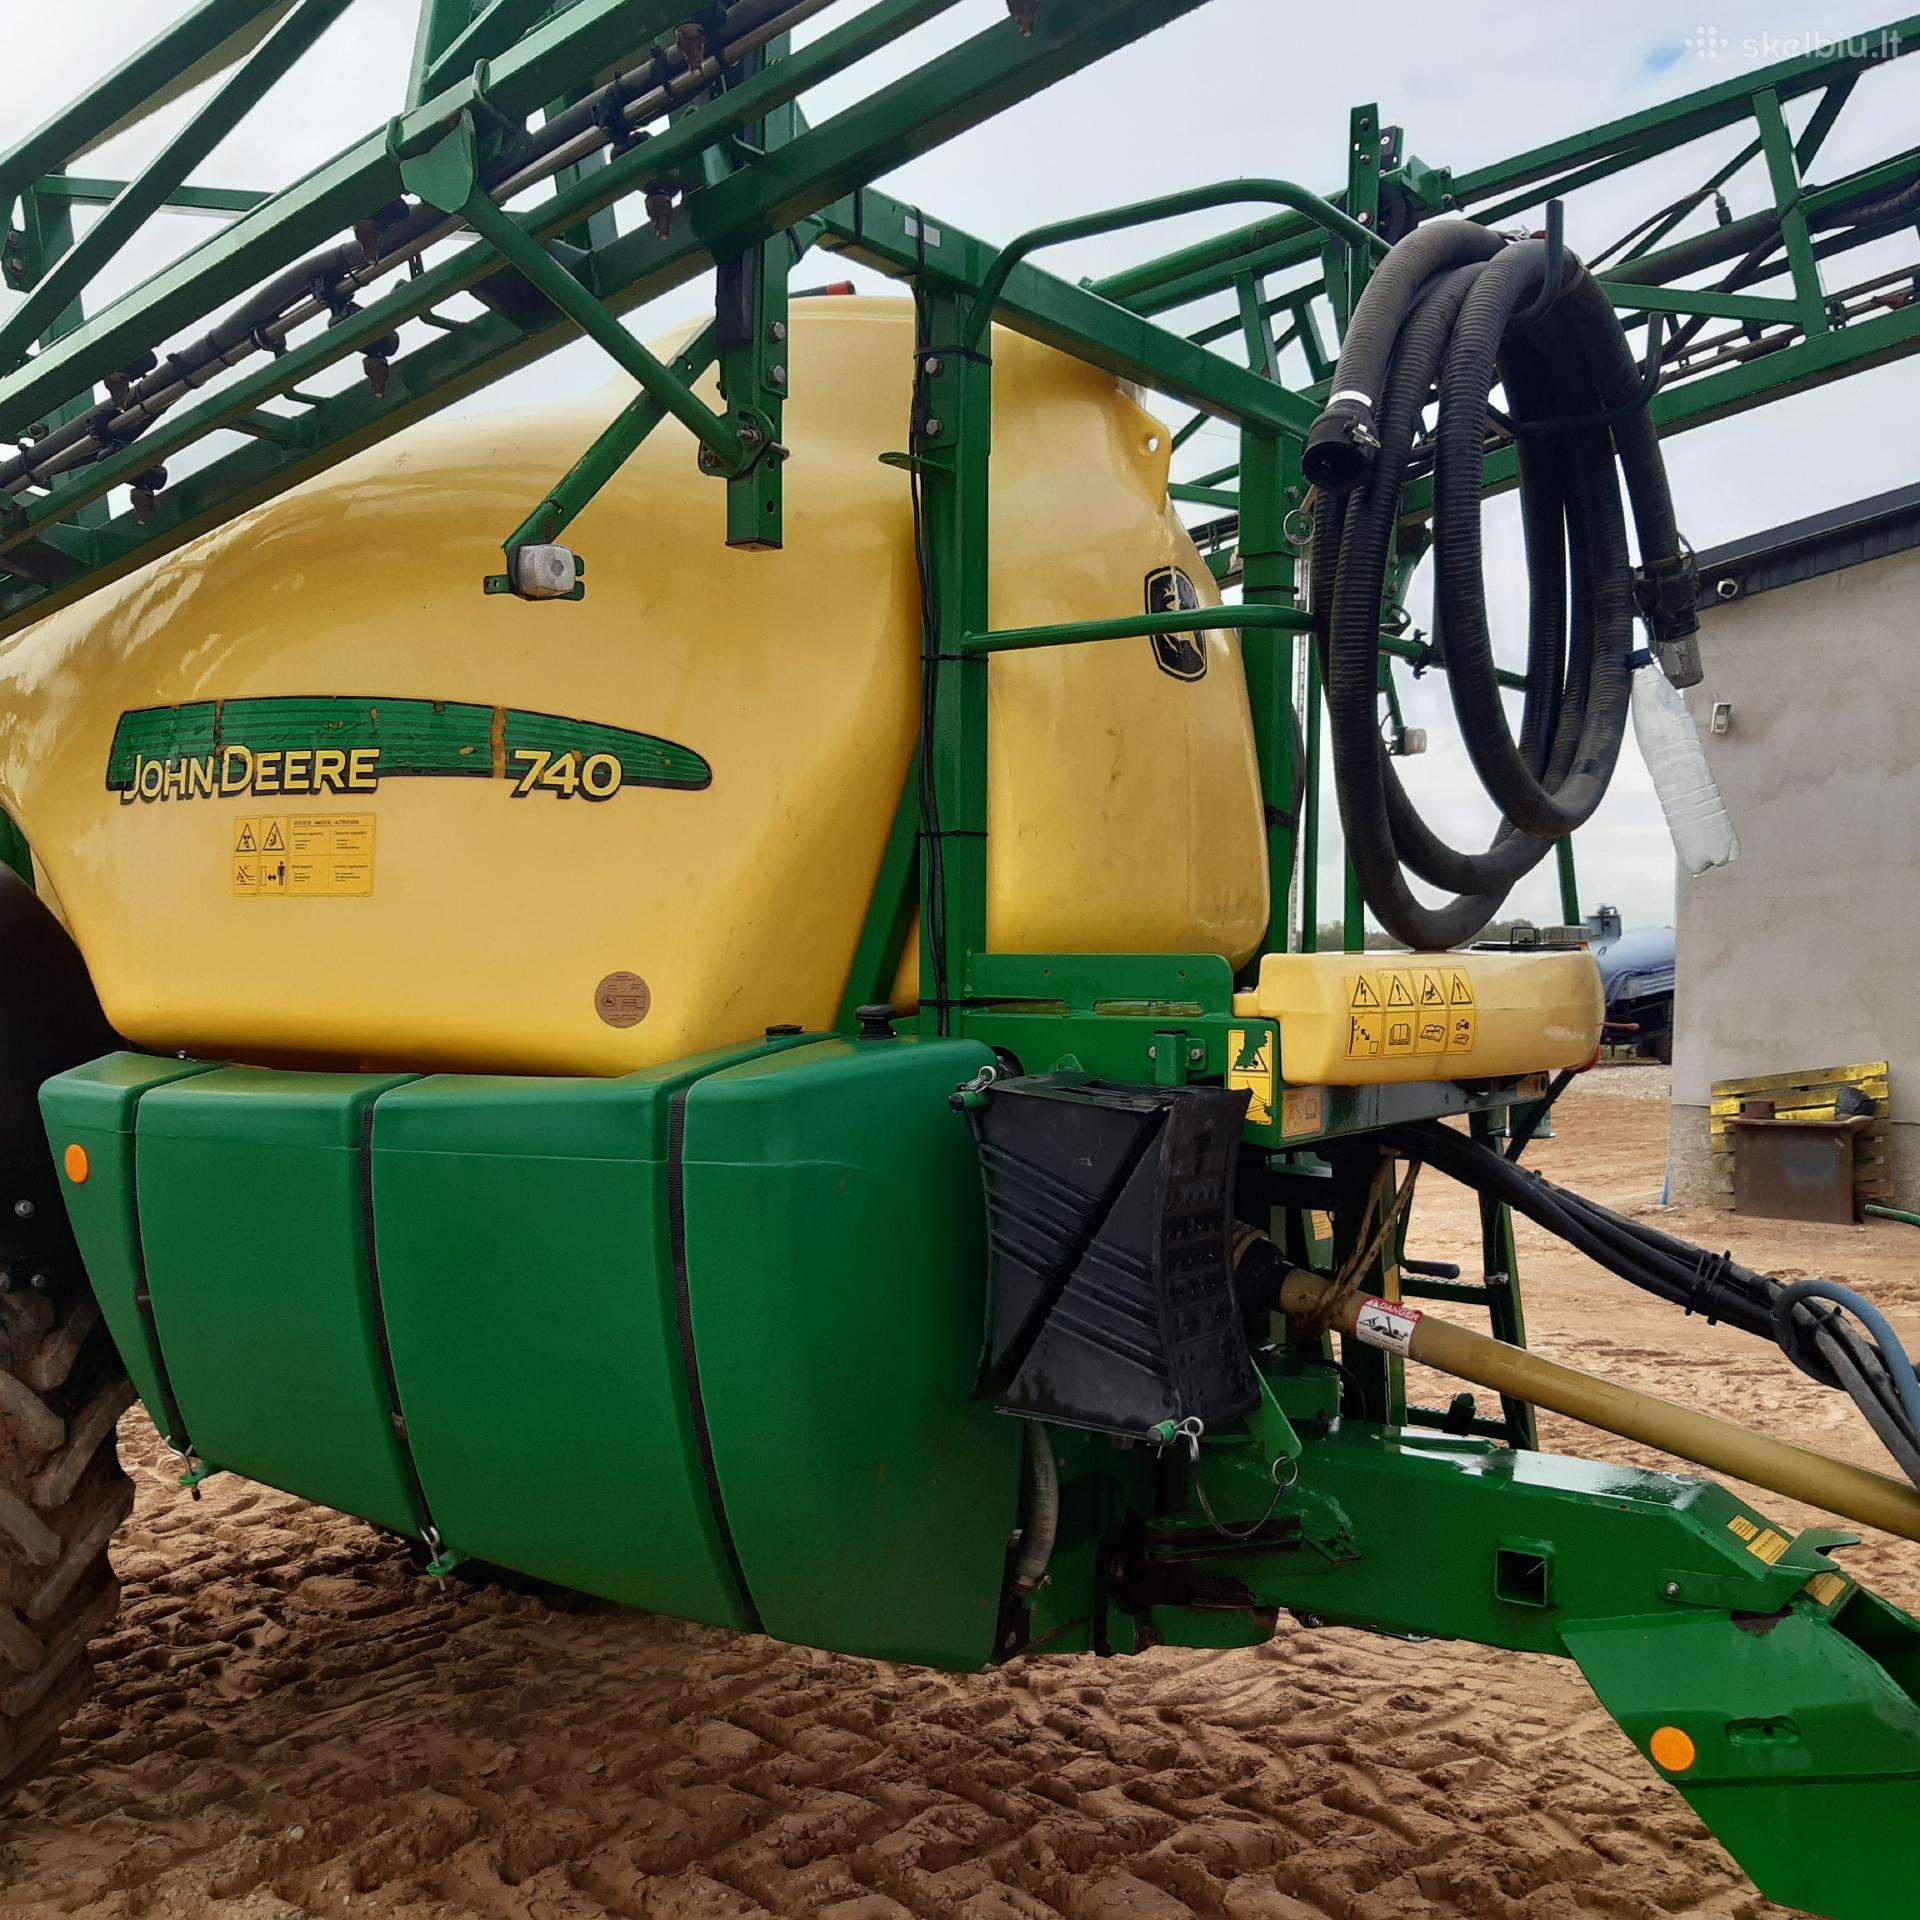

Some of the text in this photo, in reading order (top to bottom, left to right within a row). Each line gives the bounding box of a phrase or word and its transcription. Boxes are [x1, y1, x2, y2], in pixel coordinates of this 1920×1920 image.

[121, 745, 622, 802] JOHN DEERE 740
[1379, 1302, 1420, 1321] DANGER
